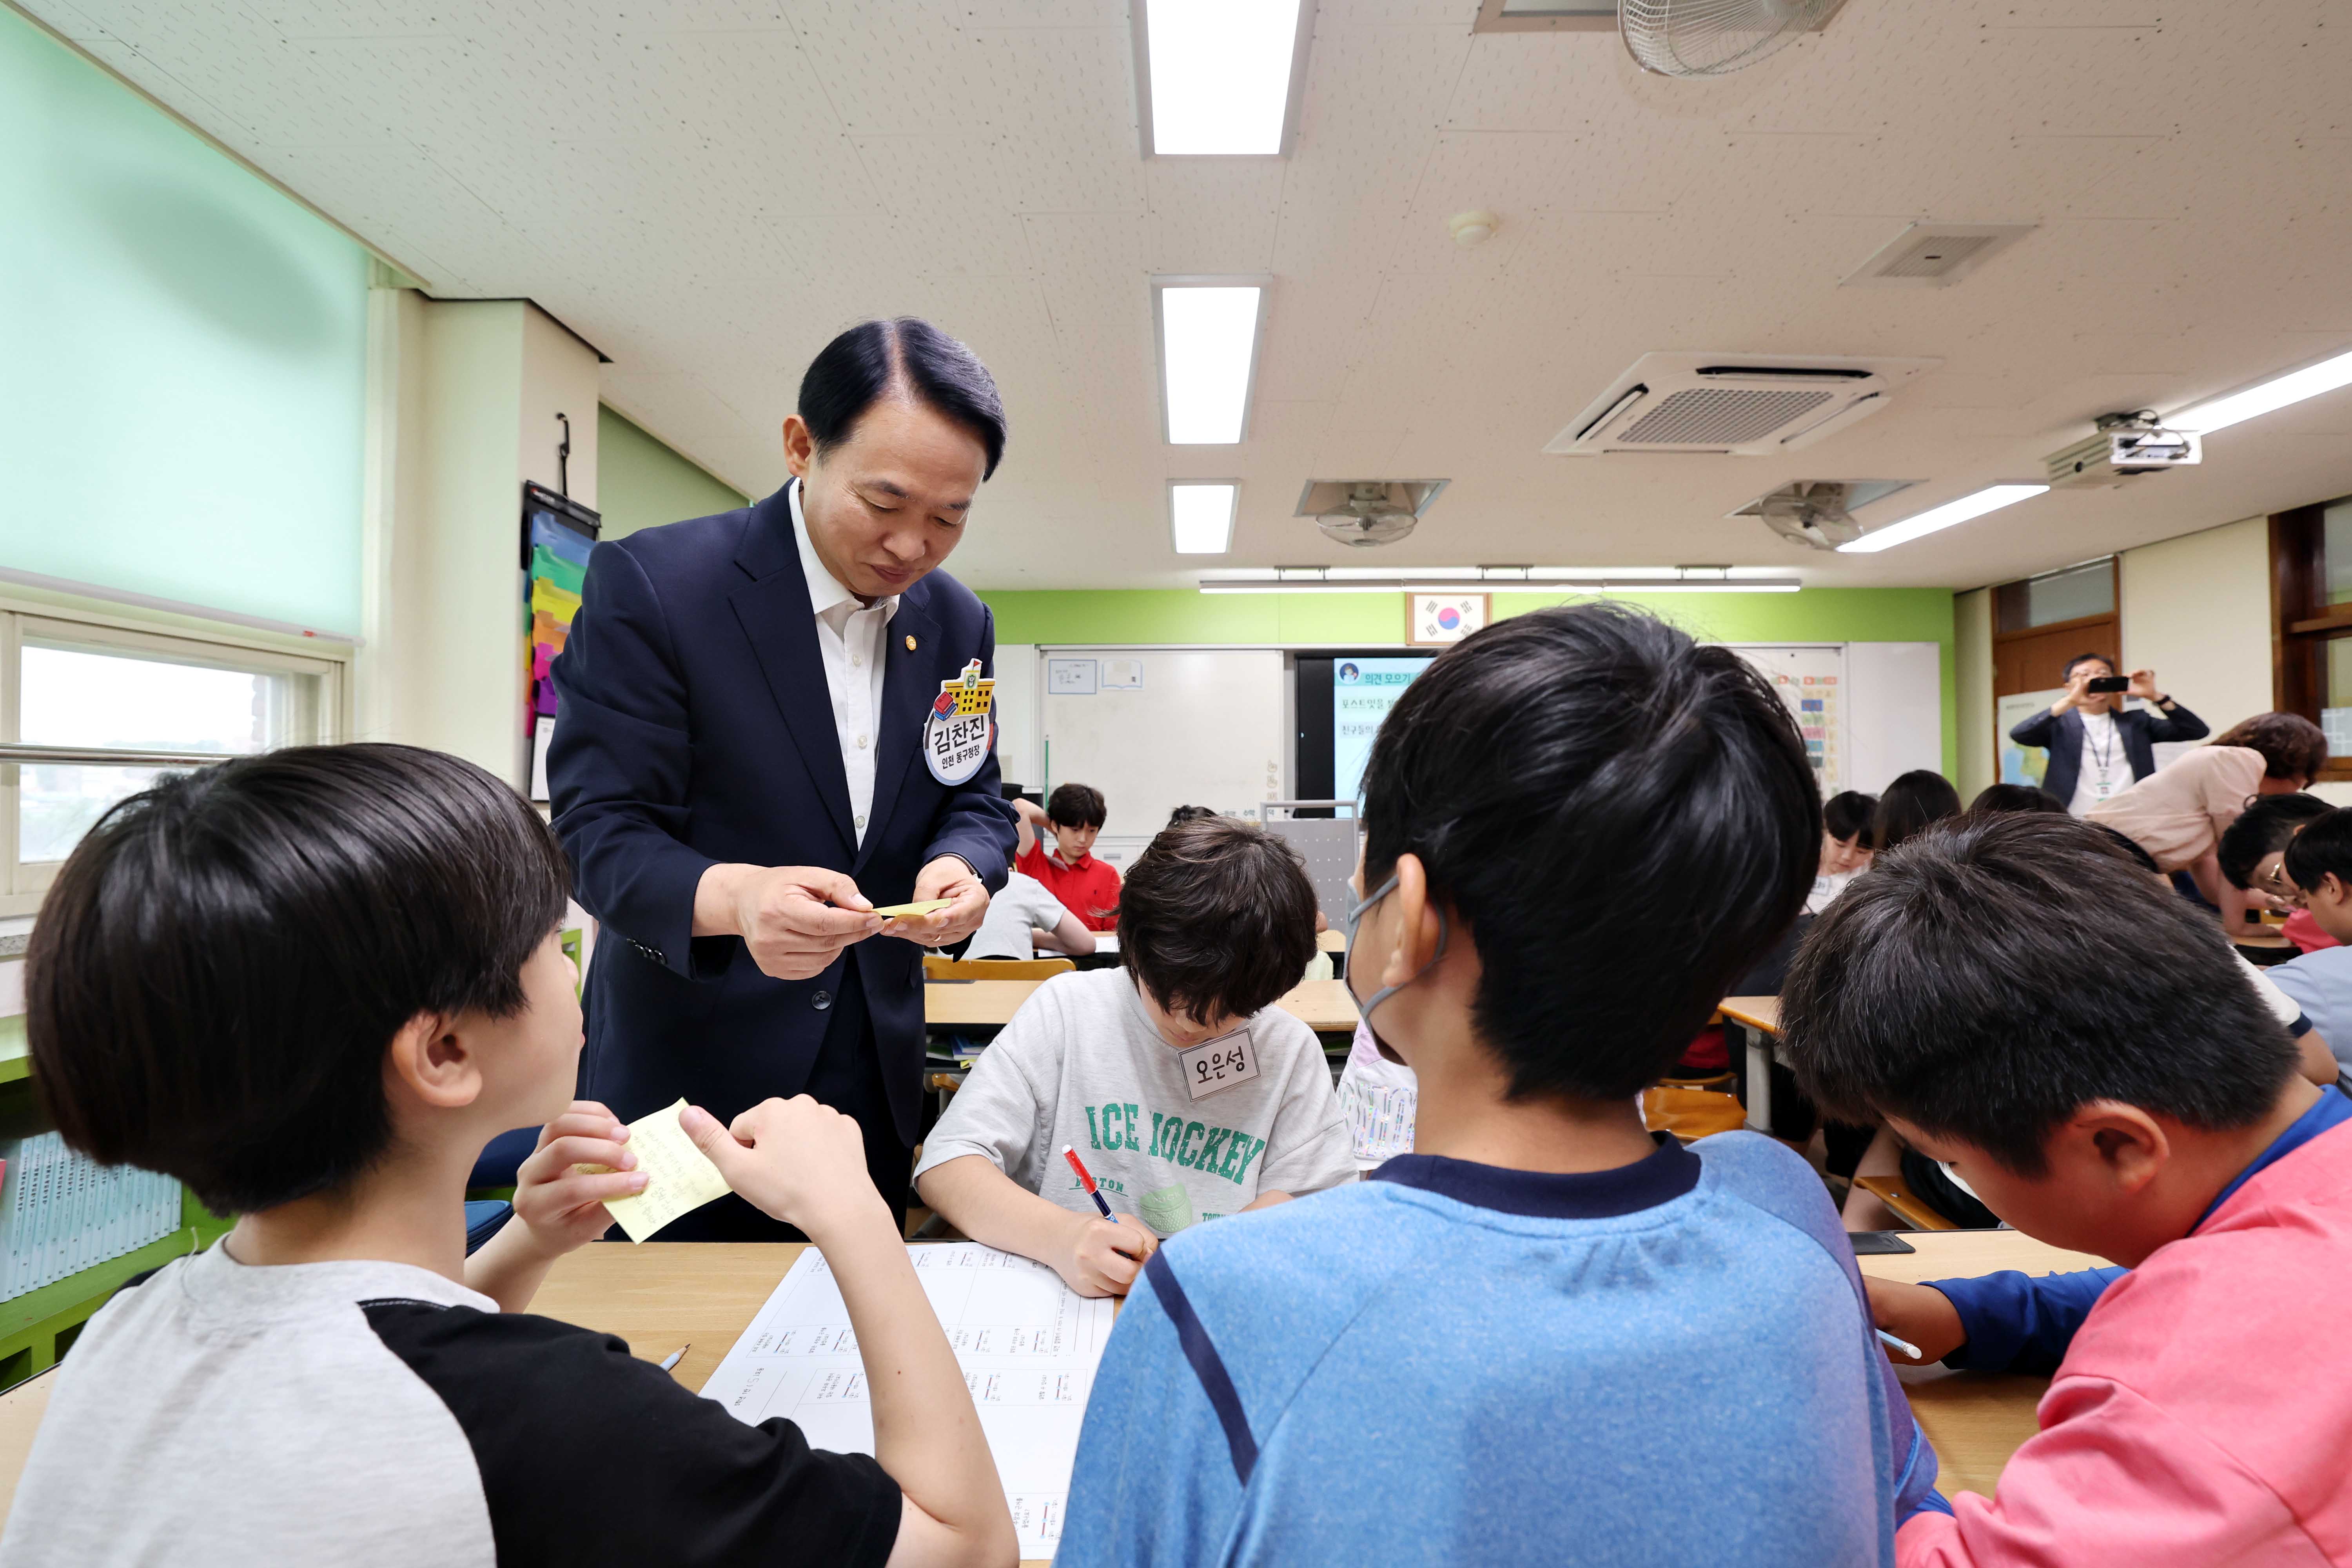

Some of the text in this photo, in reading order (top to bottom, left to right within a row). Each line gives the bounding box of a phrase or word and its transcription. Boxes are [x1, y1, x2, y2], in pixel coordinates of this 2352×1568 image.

[1365, 673, 1411, 685] 의견 모으기
[935, 715, 985, 755] 김찬진
[1341, 724, 1374, 735] 친구들의
[942, 744, 980, 769] 인천 동구청장
[1195, 1045, 1245, 1084] 오은성
[1085, 1103, 1140, 1152] ICE
[1075, 1176, 1124, 1192] BSTON
